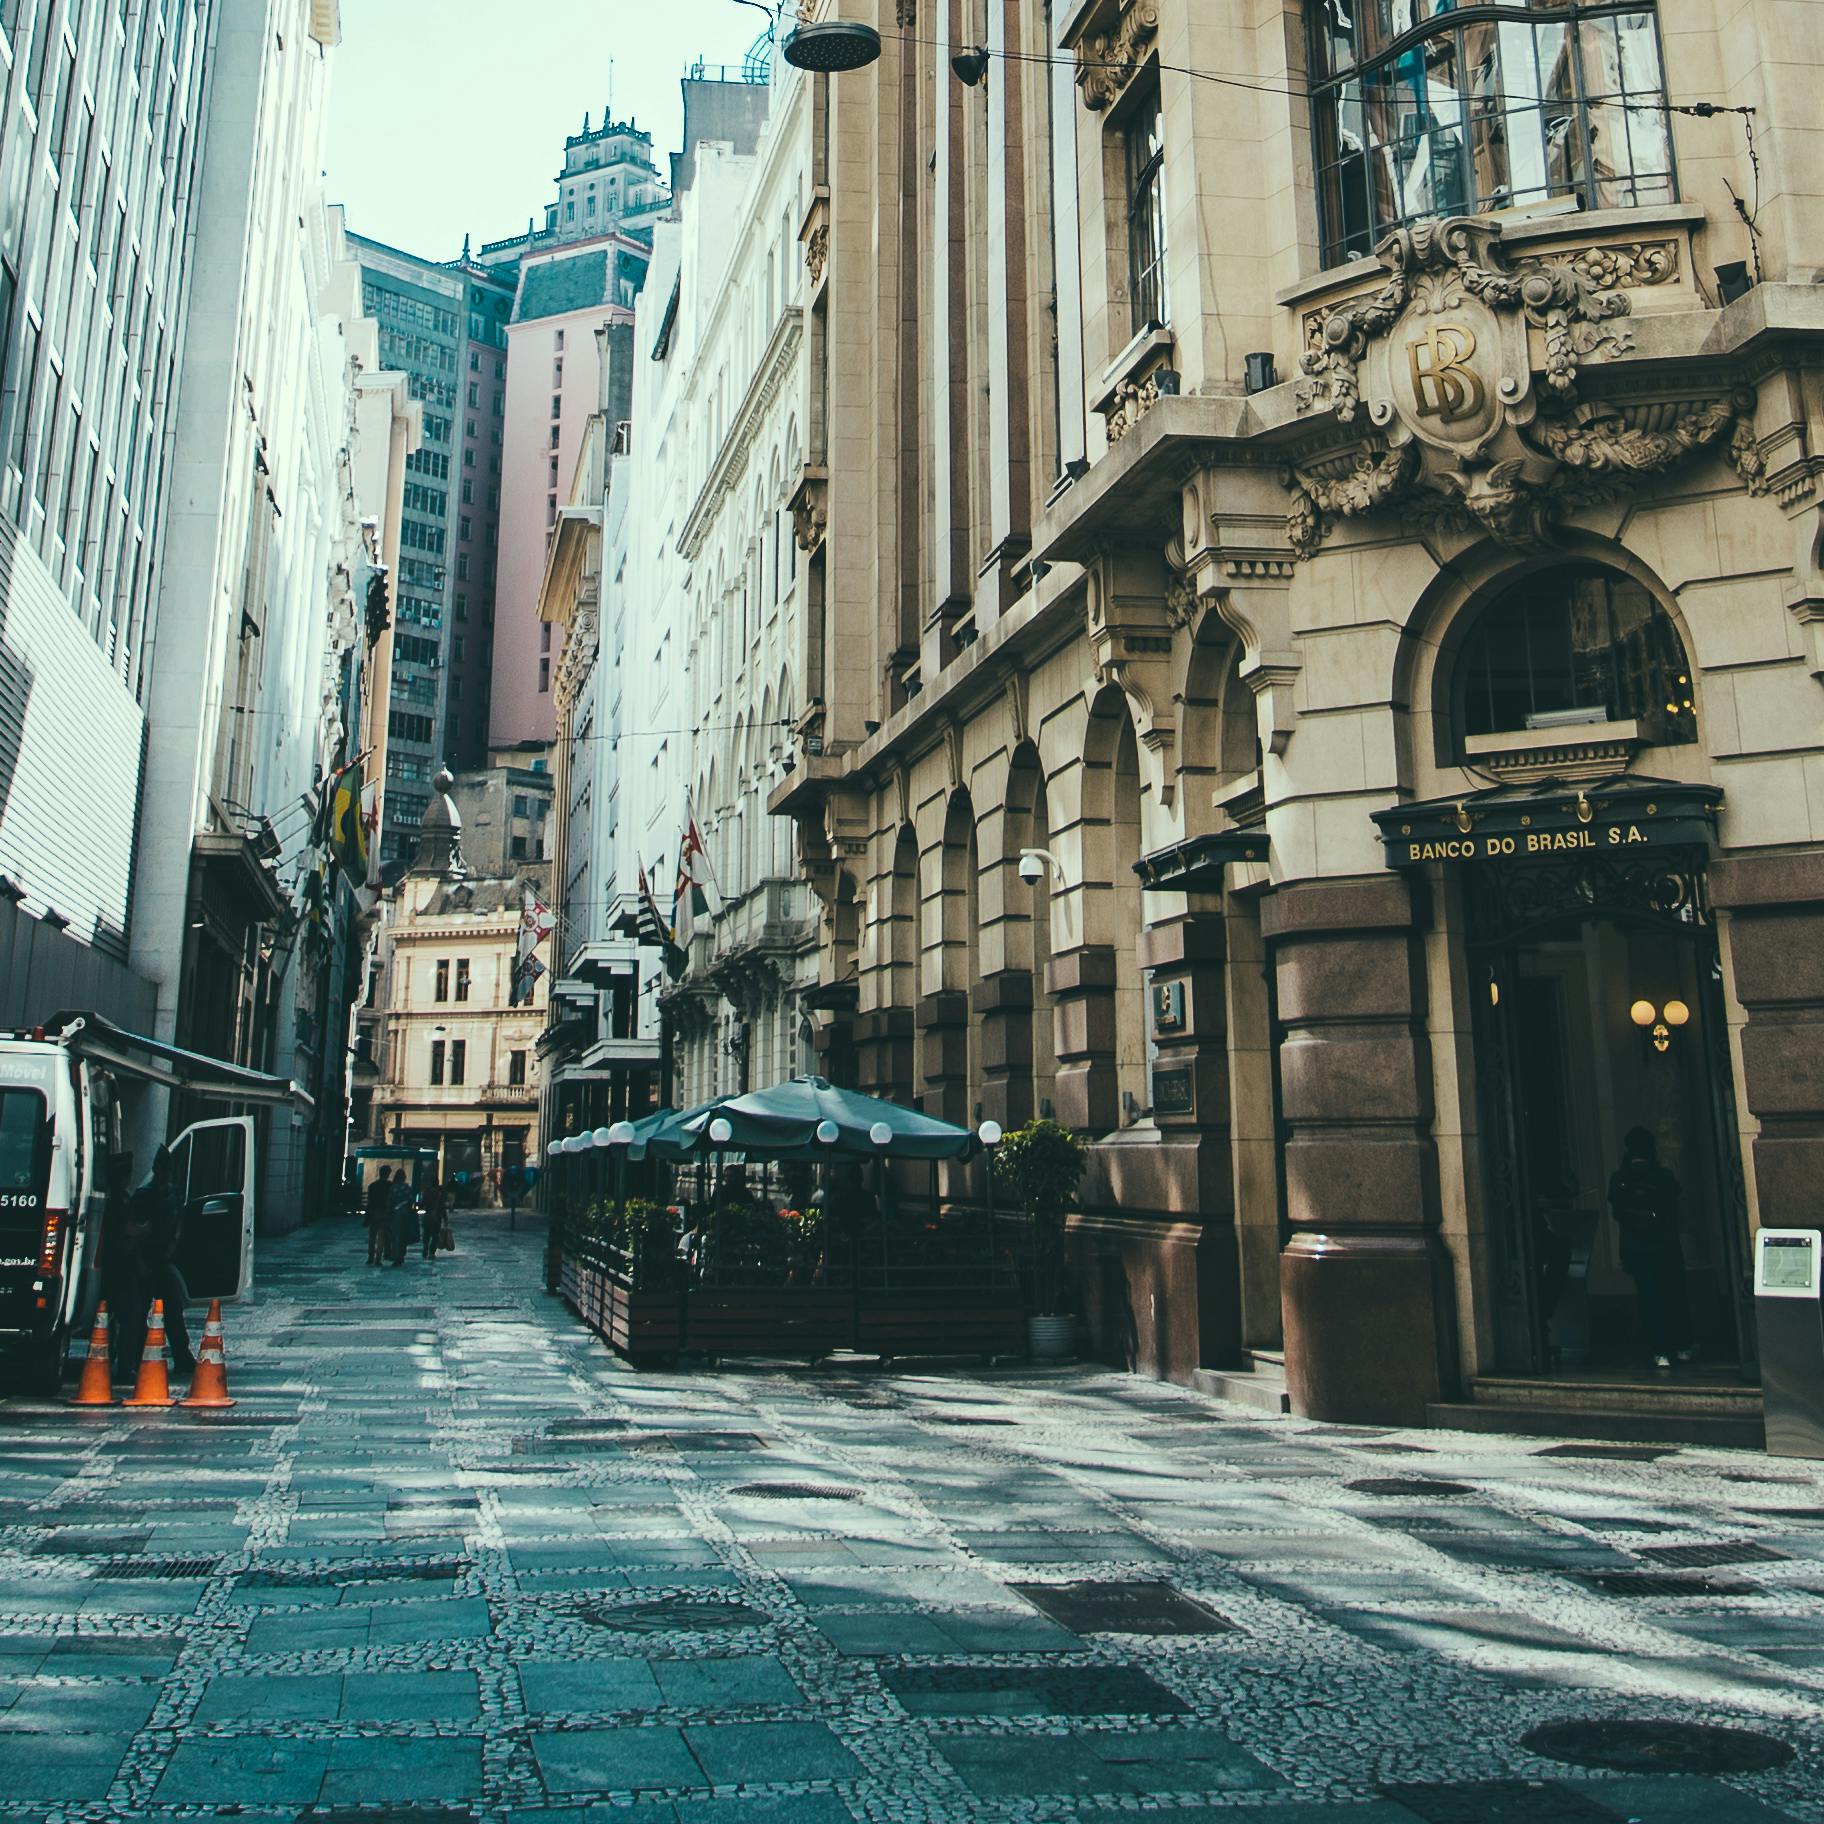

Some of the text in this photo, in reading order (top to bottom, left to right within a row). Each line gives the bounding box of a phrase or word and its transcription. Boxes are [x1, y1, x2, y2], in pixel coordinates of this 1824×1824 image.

[1409, 825, 1648, 860] BANCO DO BRASIL S.A.
